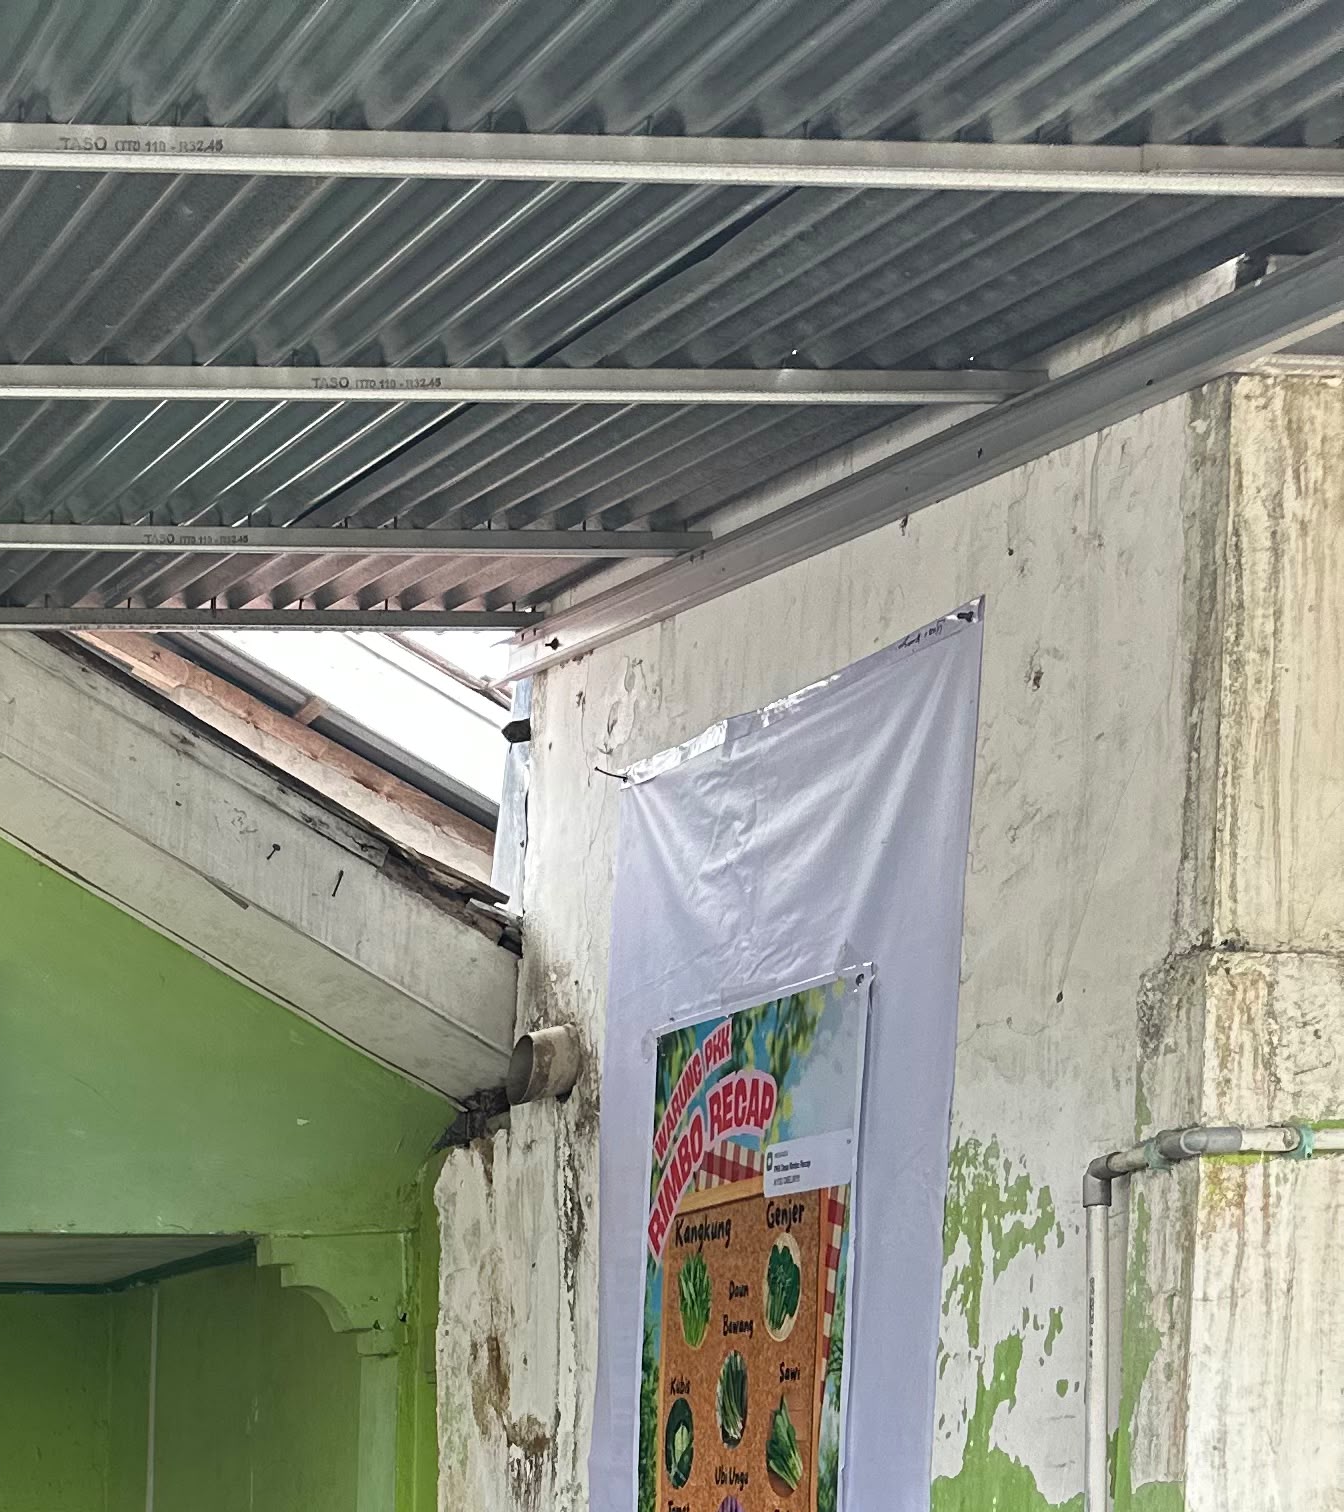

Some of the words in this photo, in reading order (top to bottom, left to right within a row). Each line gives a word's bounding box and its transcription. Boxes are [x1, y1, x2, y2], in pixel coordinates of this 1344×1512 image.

[654, 1051, 703, 1160] WARUNG
[705, 1022, 732, 1072] PKK
[648, 1113, 704, 1257] RIMBO
[708, 1077, 775, 1142] RECAP
[675, 1214, 732, 1252] Kangkung
[766, 1199, 804, 1233] Genjer
[729, 1280, 749, 1300] Daun
[723, 1314, 754, 1339] Bawang
[779, 1361, 801, 1383] Sawi
